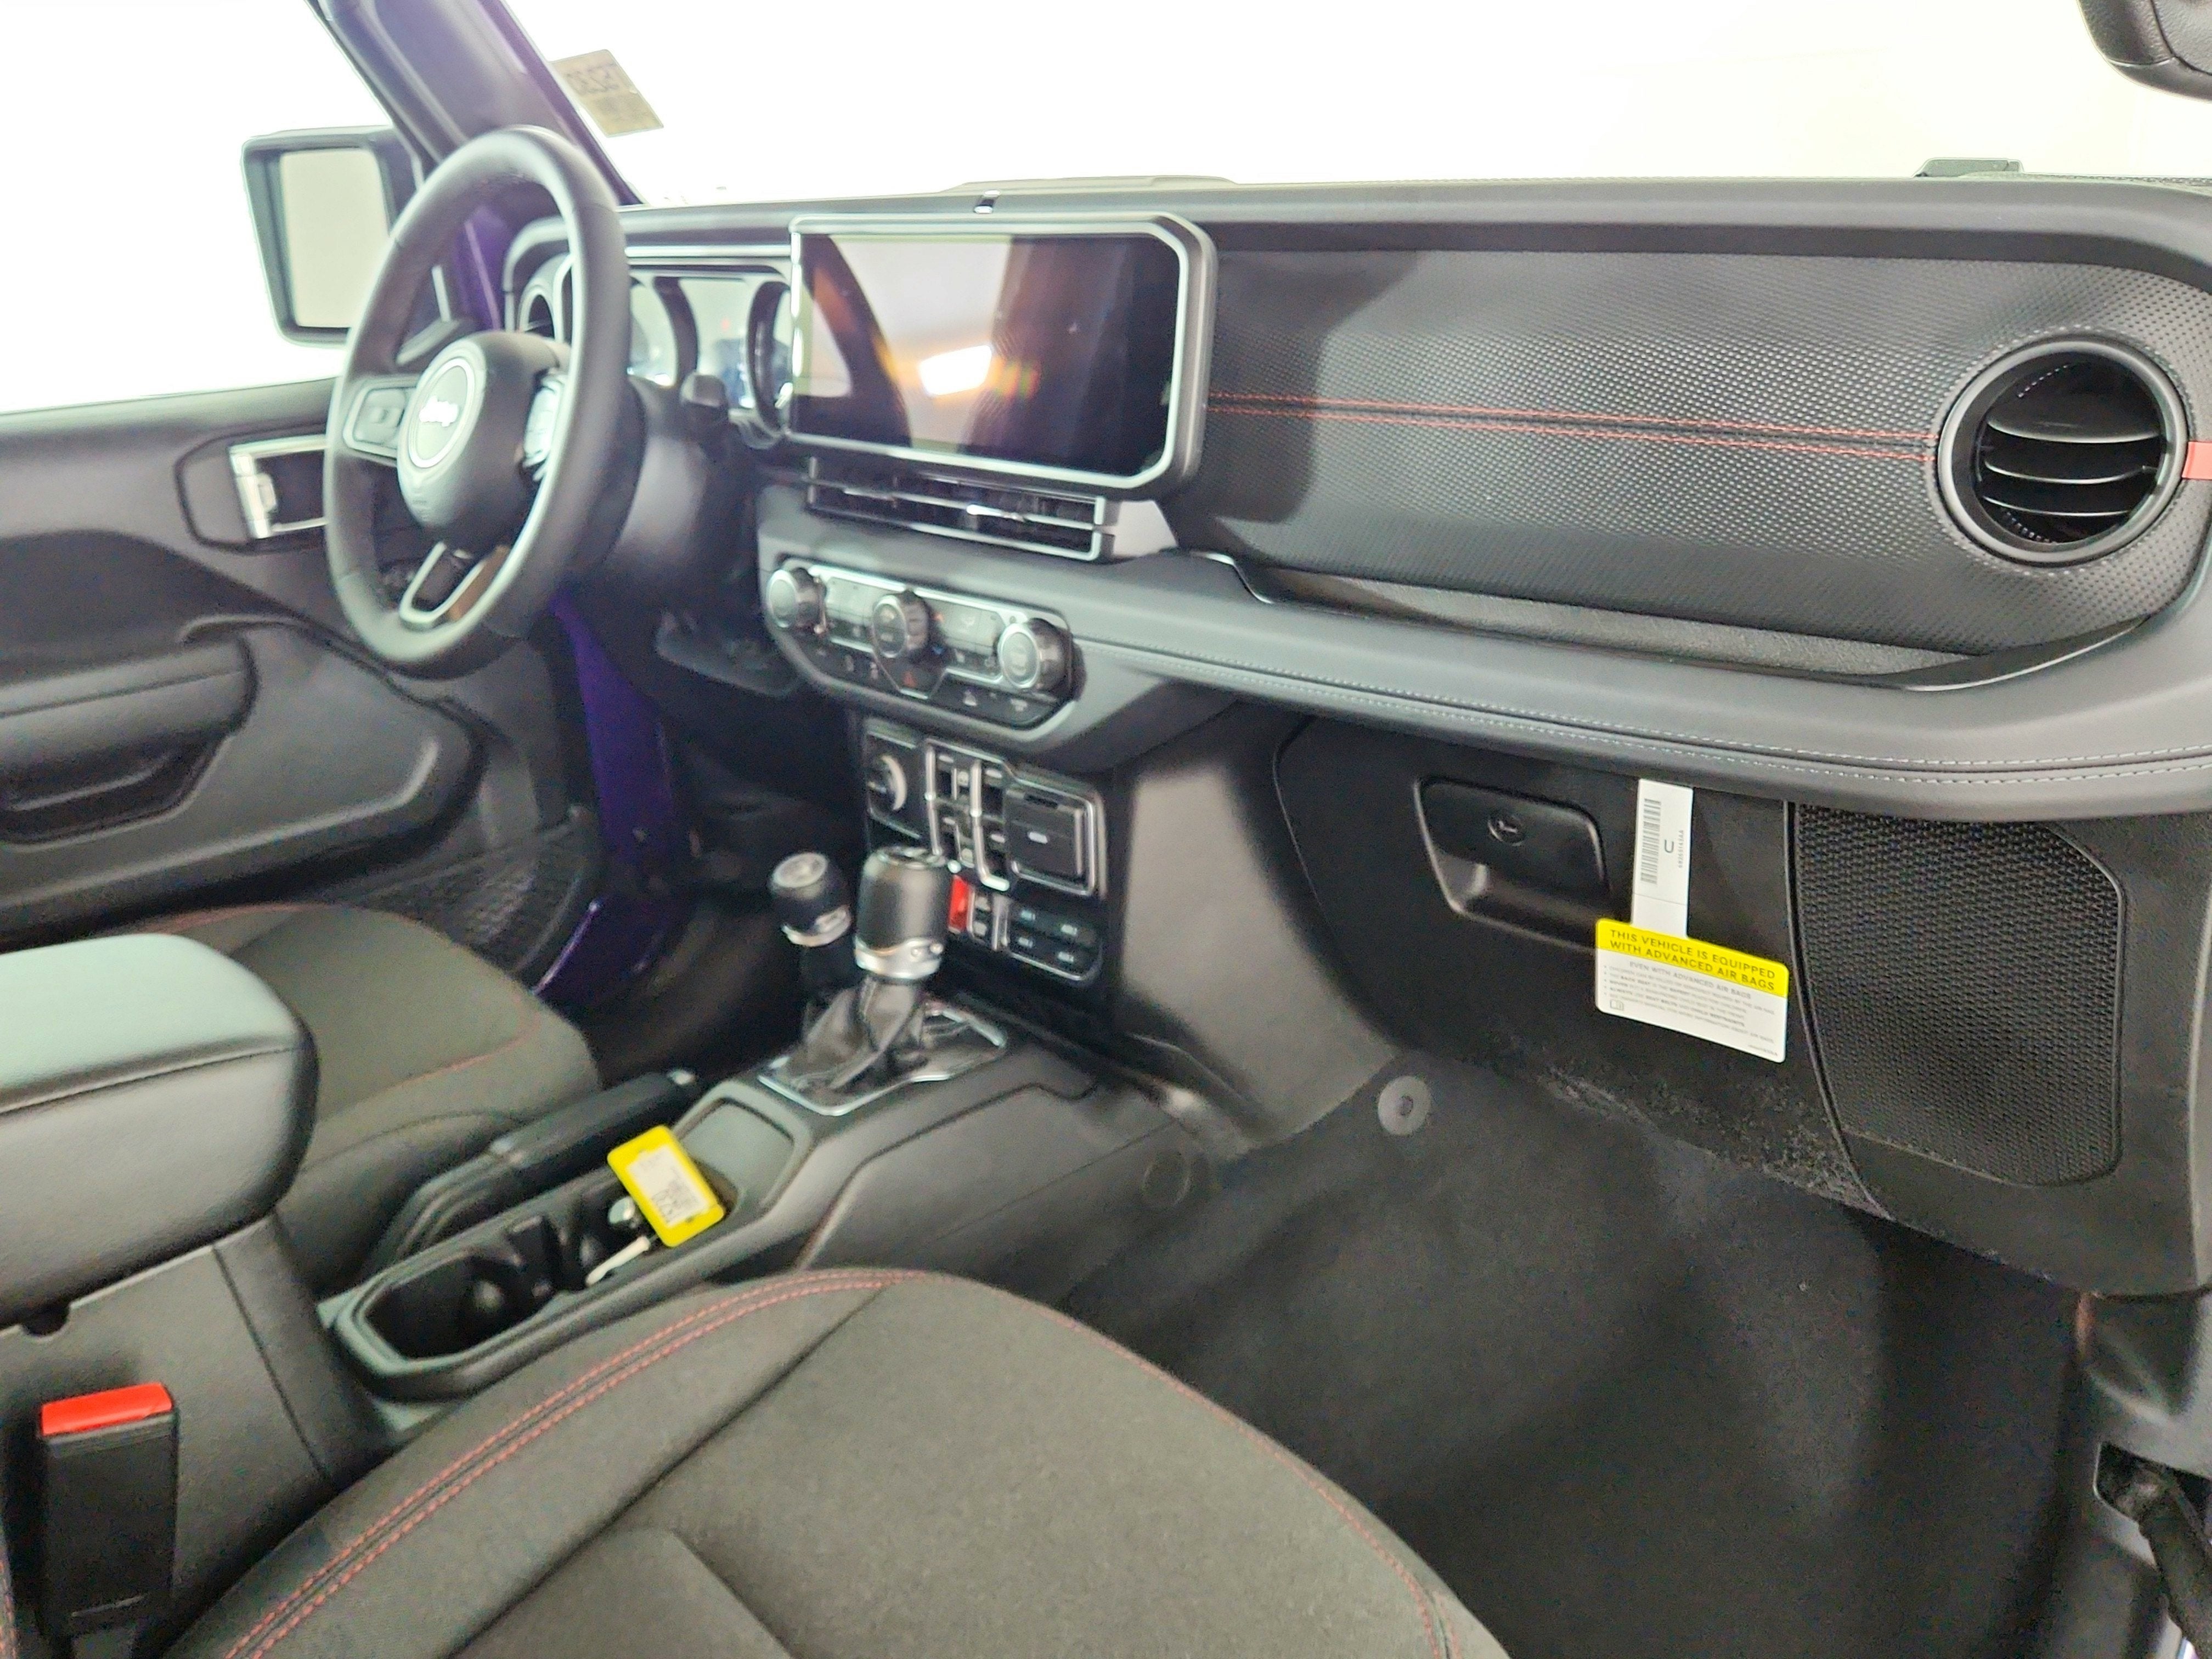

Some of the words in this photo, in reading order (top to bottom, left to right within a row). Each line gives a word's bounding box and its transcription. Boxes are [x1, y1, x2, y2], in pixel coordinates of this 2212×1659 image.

[1611, 930, 1638, 943] THIS
[1642, 936, 1692, 956] VEHICLE
[1697, 950, 1708, 960] IS
[1713, 954, 1775, 979] EQUIPPED
[1611, 940, 1641, 954] WITH
[1646, 948, 1713, 972] ADVANCED
[1717, 967, 1737, 981] AIR
[1741, 974, 1775, 991] BAGS
[1629, 961, 1649, 971] EVEN
[1673, 972, 1714, 988] ADVANCED
[1717, 983, 1729, 992] AIR
[1731, 988, 1751, 999] BAGS
